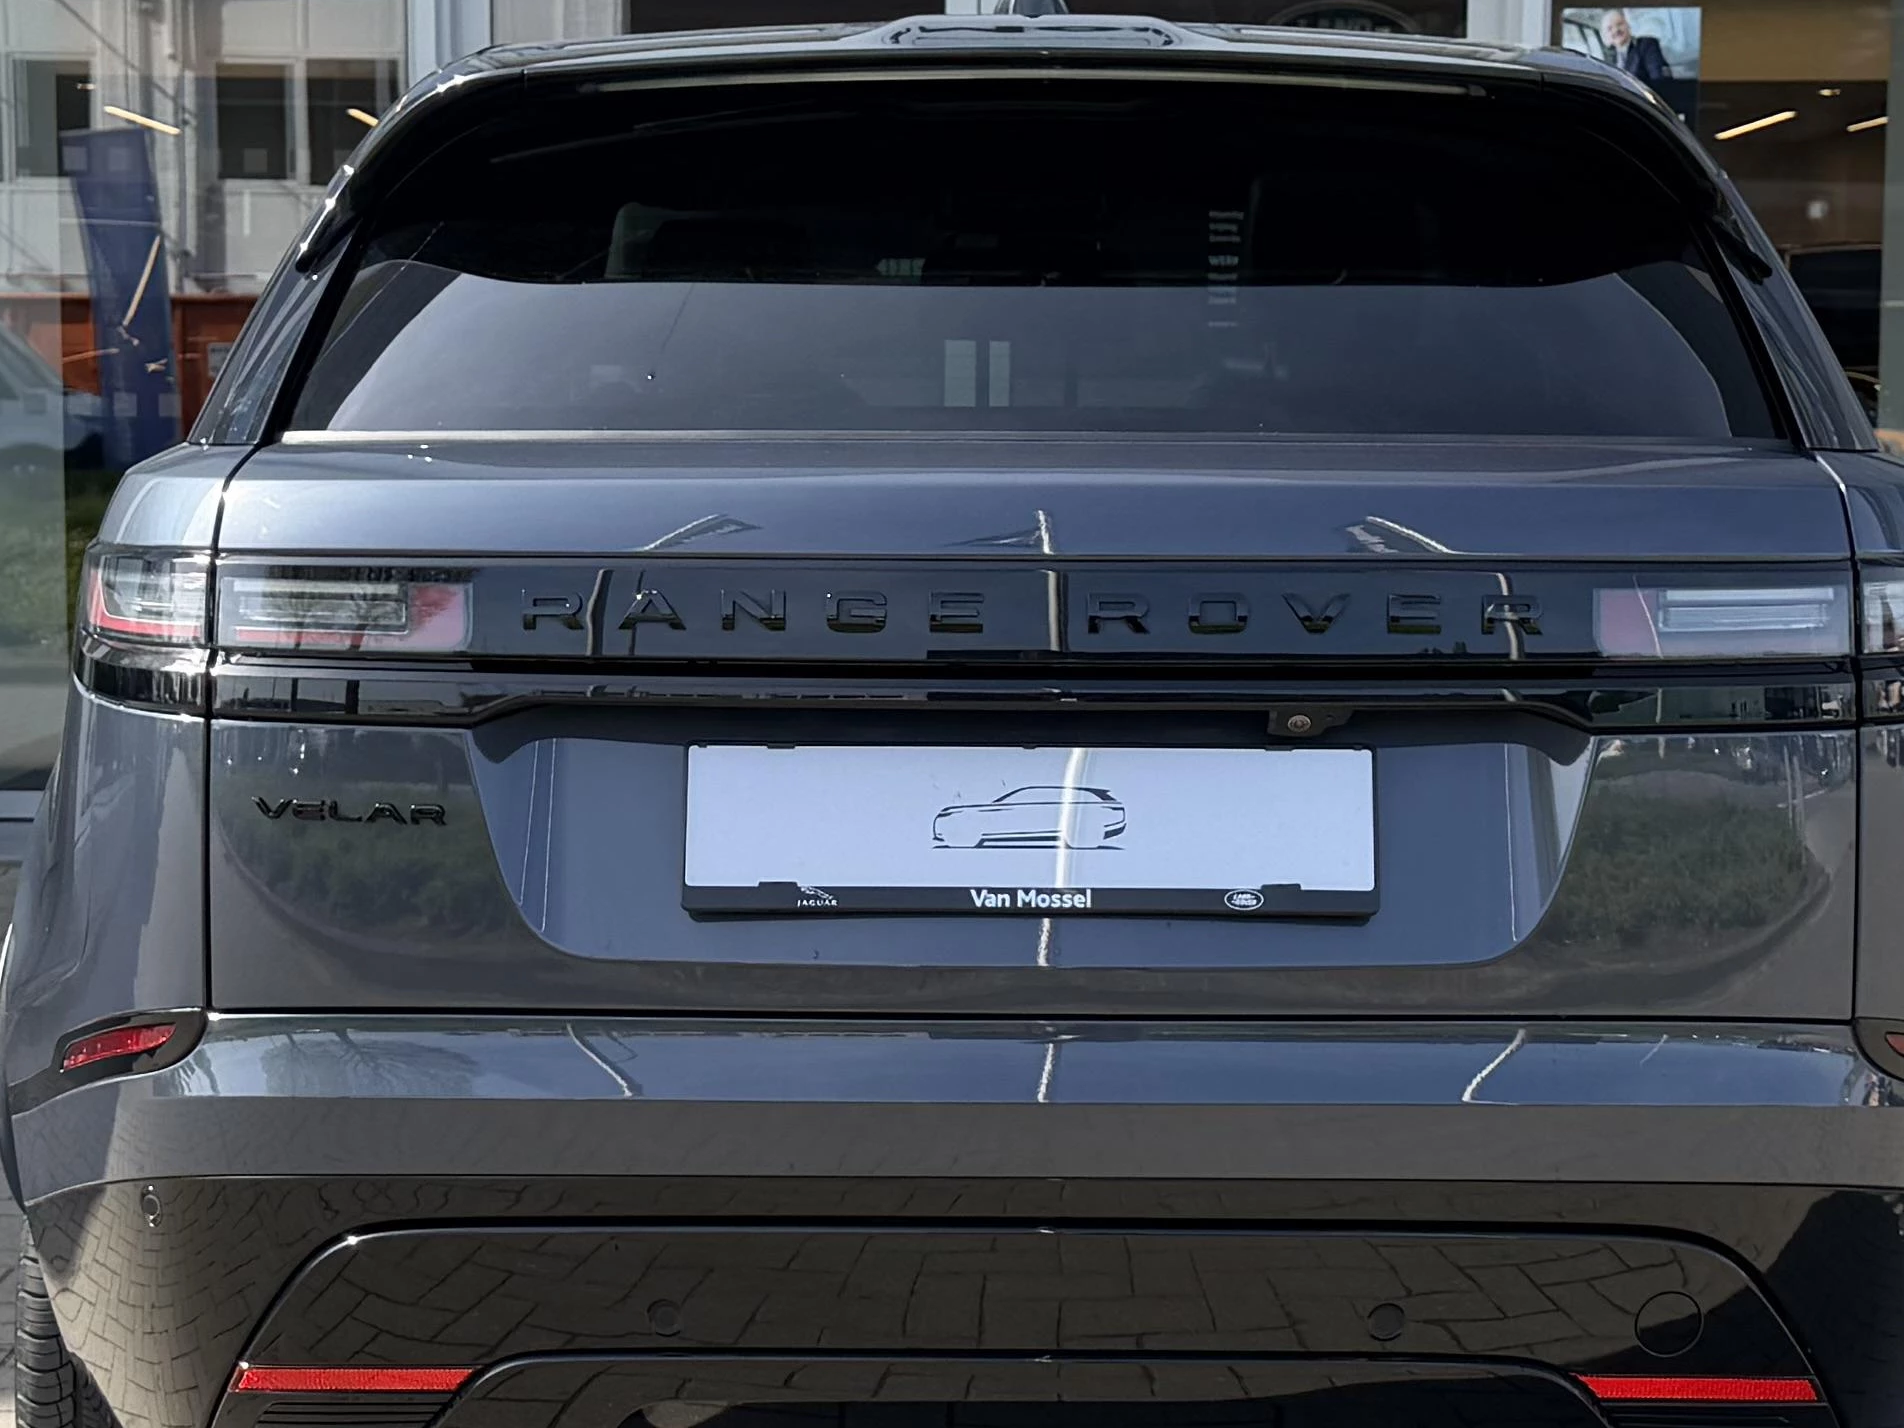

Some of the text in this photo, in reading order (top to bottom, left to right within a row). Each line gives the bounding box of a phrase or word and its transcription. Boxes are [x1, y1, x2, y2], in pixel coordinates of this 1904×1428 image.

[520, 588, 1545, 636] RANGE ROVER
[251, 795, 448, 827] VELAR
[797, 899, 838, 908] JAGUAR
[969, 888, 1093, 909] Van Mossel
